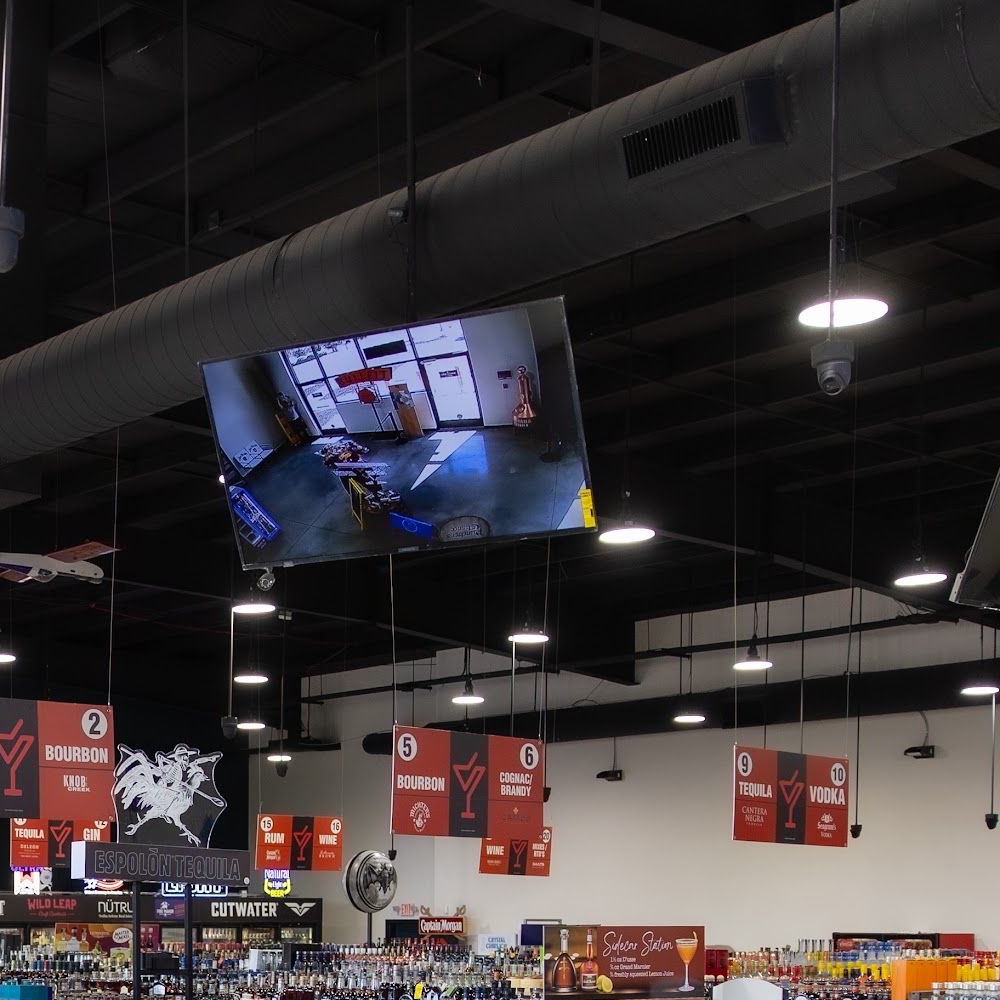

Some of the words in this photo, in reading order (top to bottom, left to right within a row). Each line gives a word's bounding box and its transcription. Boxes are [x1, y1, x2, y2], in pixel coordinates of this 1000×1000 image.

[89, 712, 100, 734] 2
[403, 737, 411, 757] 5
[45, 745, 108, 764] BOURBON
[525, 746, 533, 766] 6
[742, 755, 748, 773] 9
[500, 772, 533, 785] COGNAC/
[832, 767, 844, 781] 10
[63, 775, 86, 787] KNOB
[397, 775, 445, 792] BOURBON
[501, 785, 531, 796] BRANDY
[739, 781, 772, 798] TEQUILA
[810, 786, 845, 805] VODKA
[742, 806, 767, 815] CANTERA
[263, 820, 271, 828] 15
[745, 813, 764, 823] NEGRA
[14, 828, 44, 839] TEQUILA
[83, 828, 100, 841] GIN
[265, 833, 284, 844] RUM
[319, 835, 337, 845] WINE
[487, 845, 504, 855] WINE
[175, 855, 240, 880] TEQUILA
[265, 869, 290, 878] Natural
[28, 899, 51, 910] WILD
[53, 899, 76, 910] LEAP
[211, 902, 277, 917] CUTWATER
[421, 920, 441, 933] Captain
[441, 920, 462, 933] Morgan
[603, 931, 637, 956] Sidecar
[641, 931, 673, 956] Station
